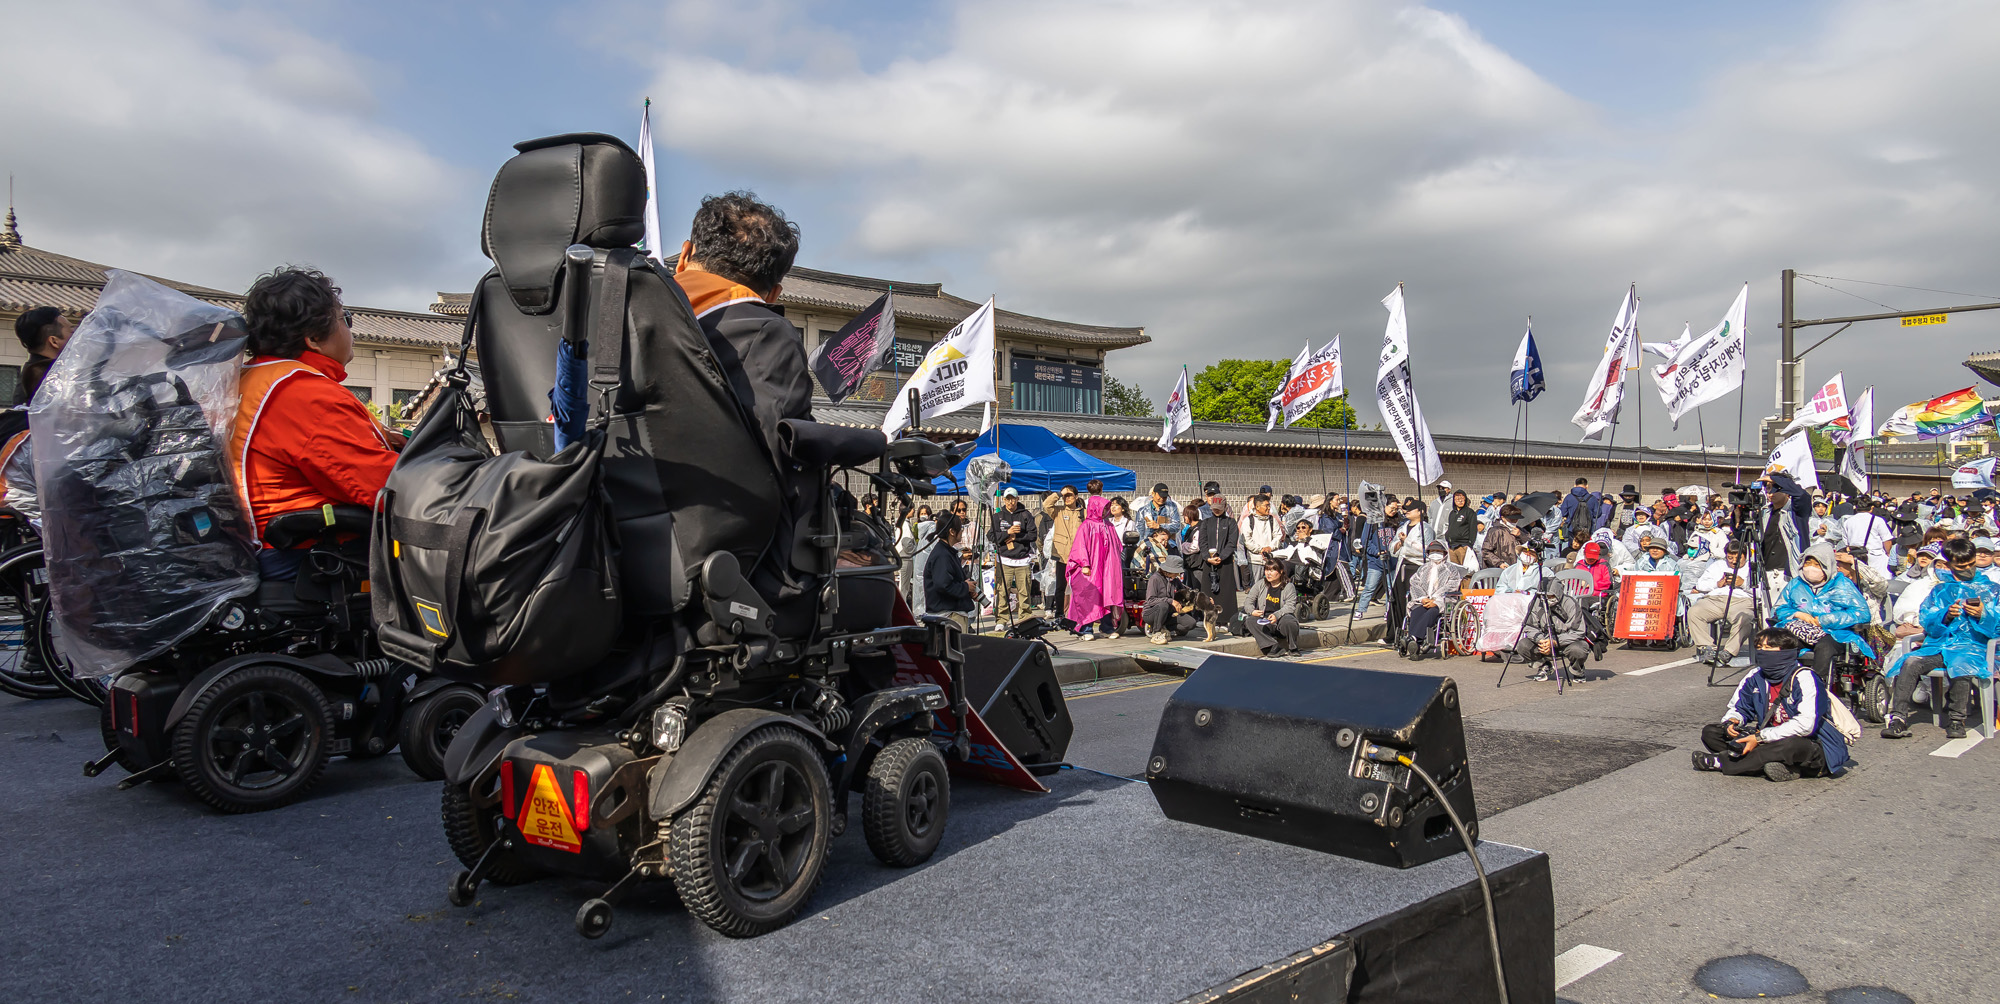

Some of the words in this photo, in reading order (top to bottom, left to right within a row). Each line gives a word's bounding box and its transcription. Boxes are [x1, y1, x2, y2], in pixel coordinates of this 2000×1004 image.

[896, 351, 925, 367] 국립고
[533, 797, 561, 818] 안전
[536, 818, 564, 839] 운전
